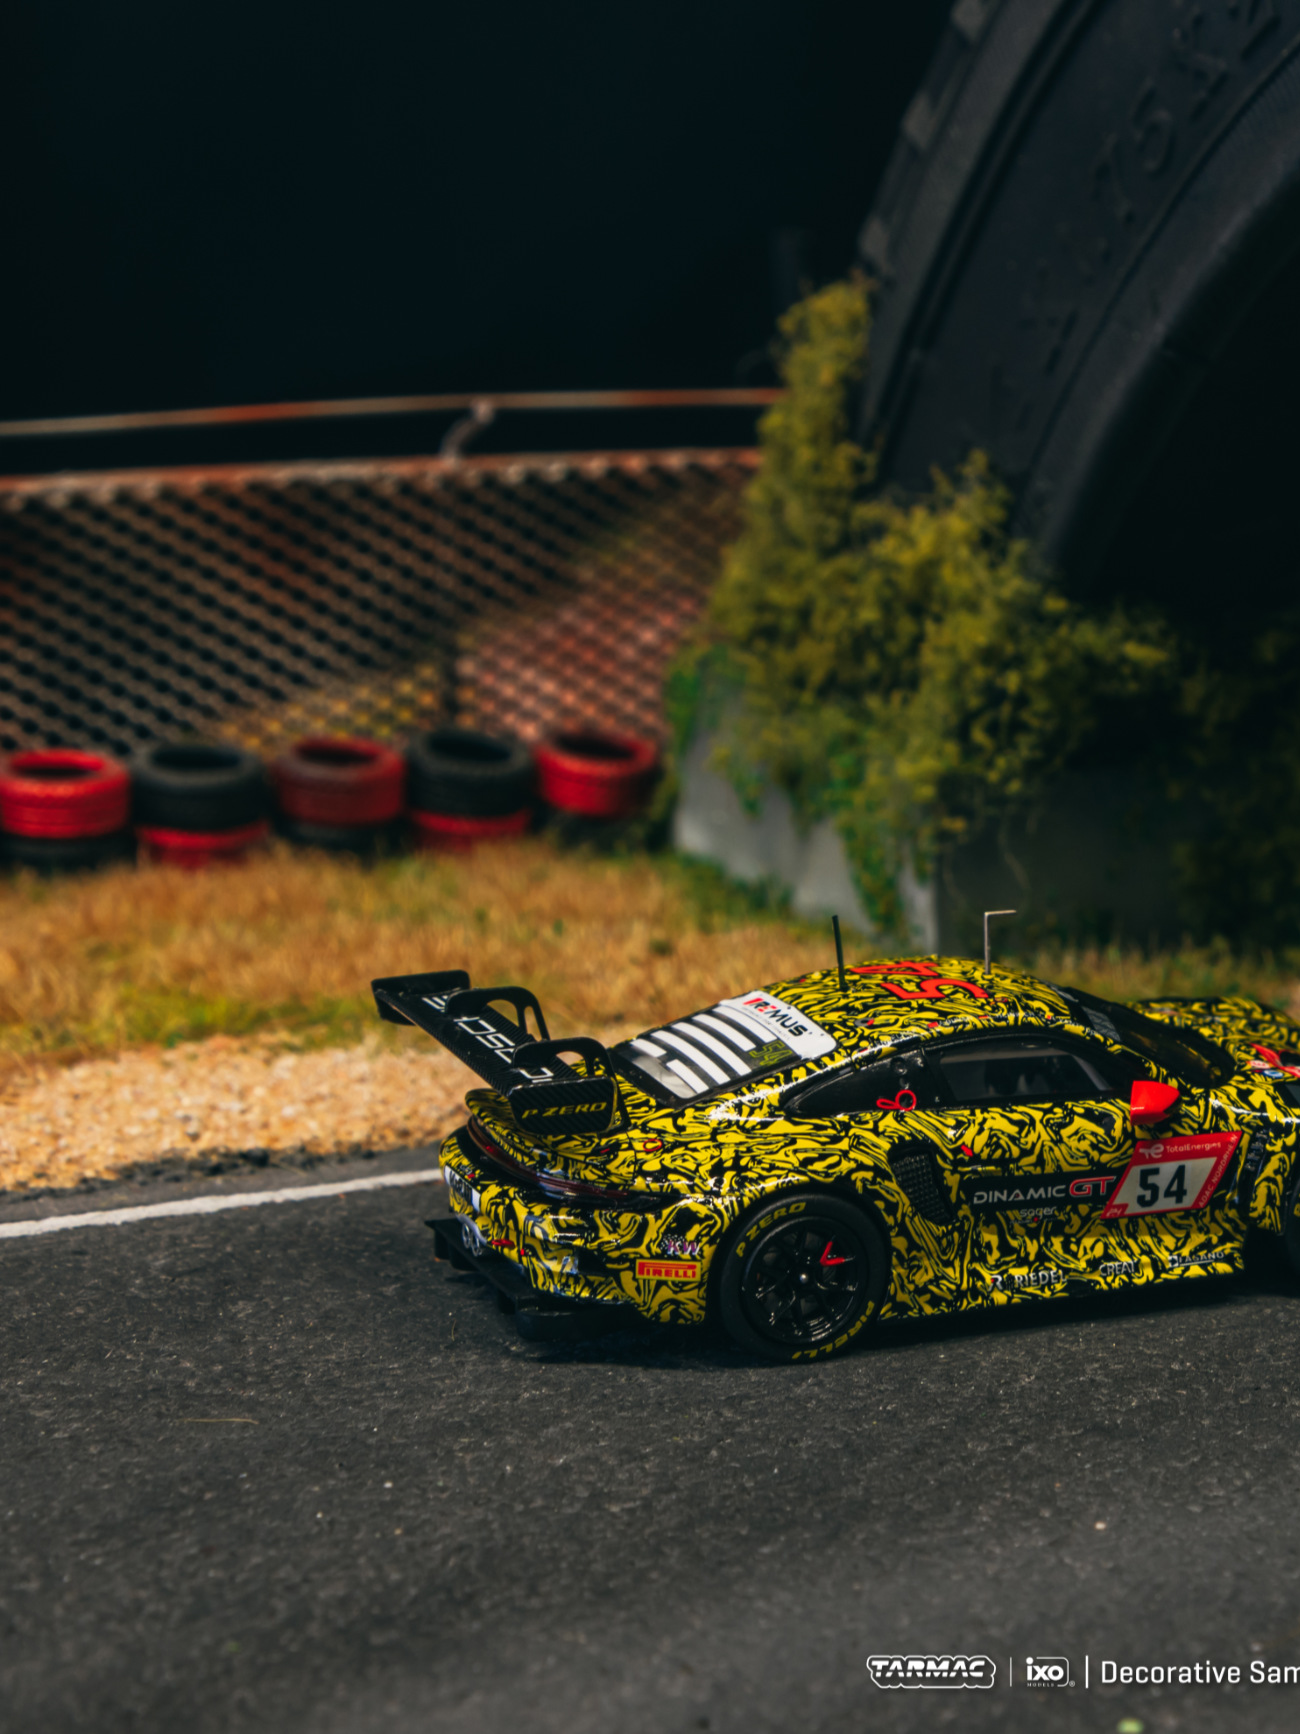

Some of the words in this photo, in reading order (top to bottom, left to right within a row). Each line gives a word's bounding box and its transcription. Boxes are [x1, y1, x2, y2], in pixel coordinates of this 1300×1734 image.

[521, 1108, 538, 1119] P
[542, 1101, 607, 1118] ZERO
[972, 1184, 1066, 1205] DINAMIC
[1069, 1175, 1117, 1198] GT
[1136, 1163, 1188, 1209] 54
[1198, 1184, 1214, 1208] ADAC
[736, 1242, 746, 1258] P
[746, 1202, 806, 1241] ZERO
[637, 1261, 697, 1279] PIRELLI
[1014, 1269, 1068, 1288] RIEDEL
